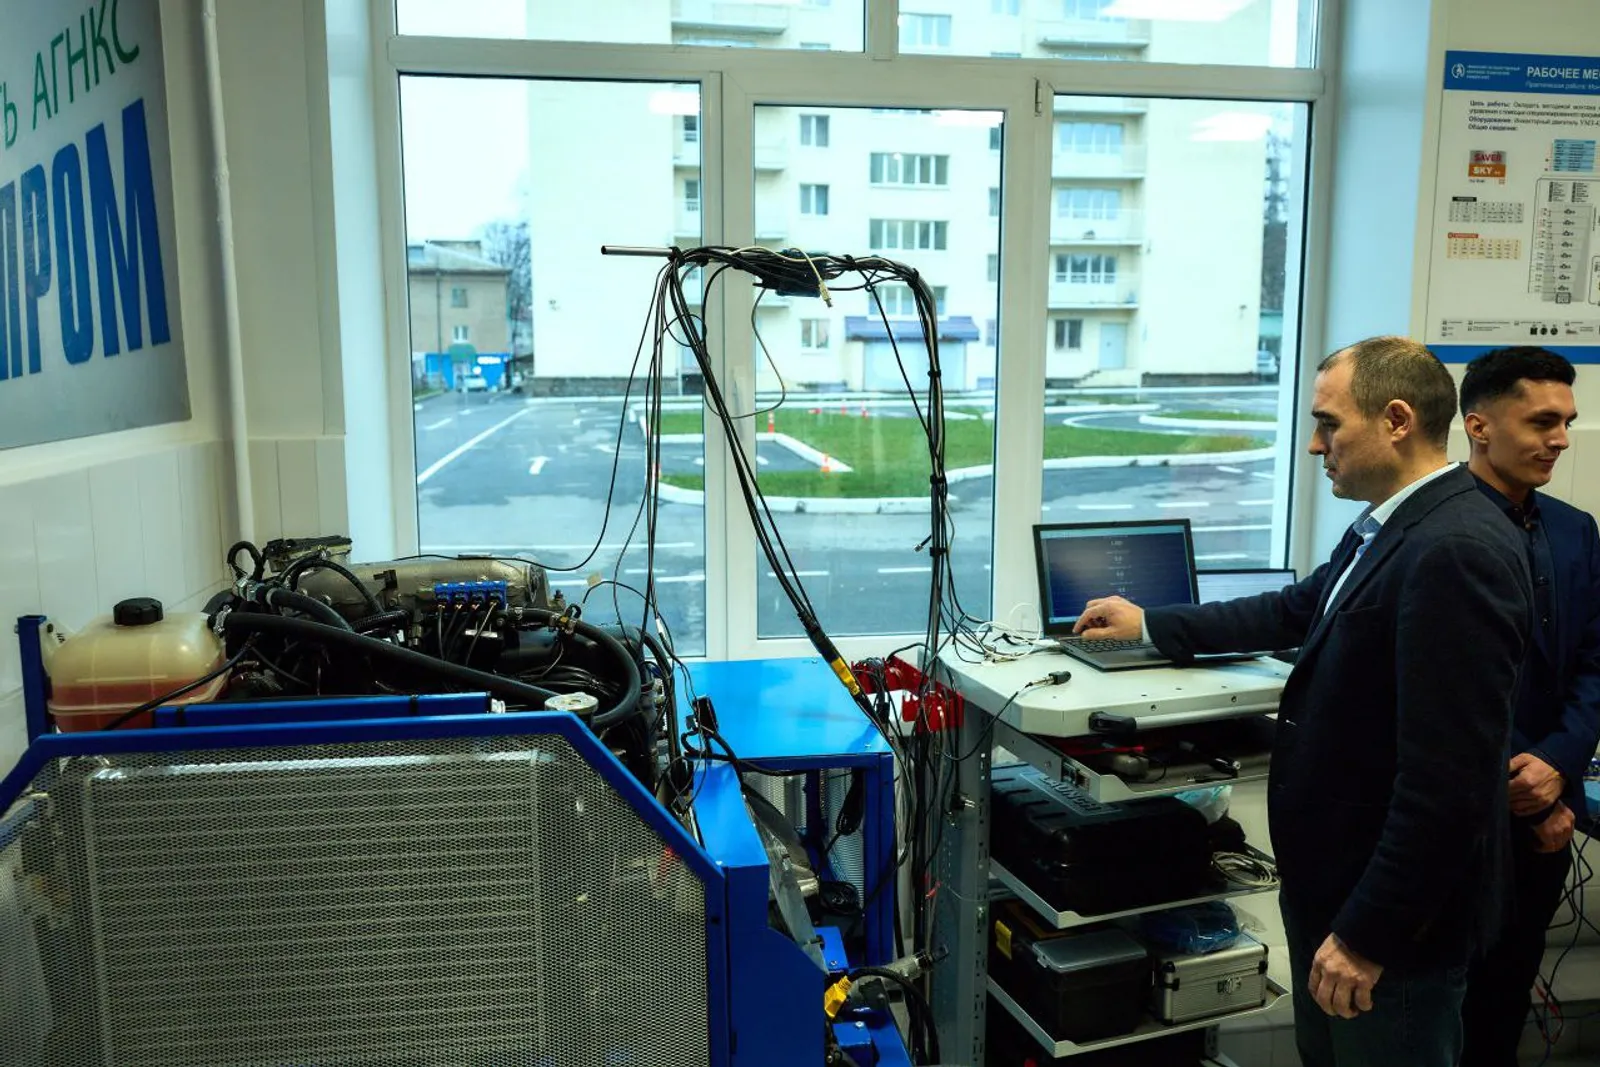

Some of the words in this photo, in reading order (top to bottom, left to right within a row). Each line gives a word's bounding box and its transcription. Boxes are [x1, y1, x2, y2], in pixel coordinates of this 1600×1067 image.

[0, 82, 18, 151] Ь
[32, 0, 140, 131] АГНКС
[1527, 66, 1580, 79] РАБОЧЕЕ
[1582, 68, 1600, 80] МЕ
[1473, 166, 1493, 175] SKY
